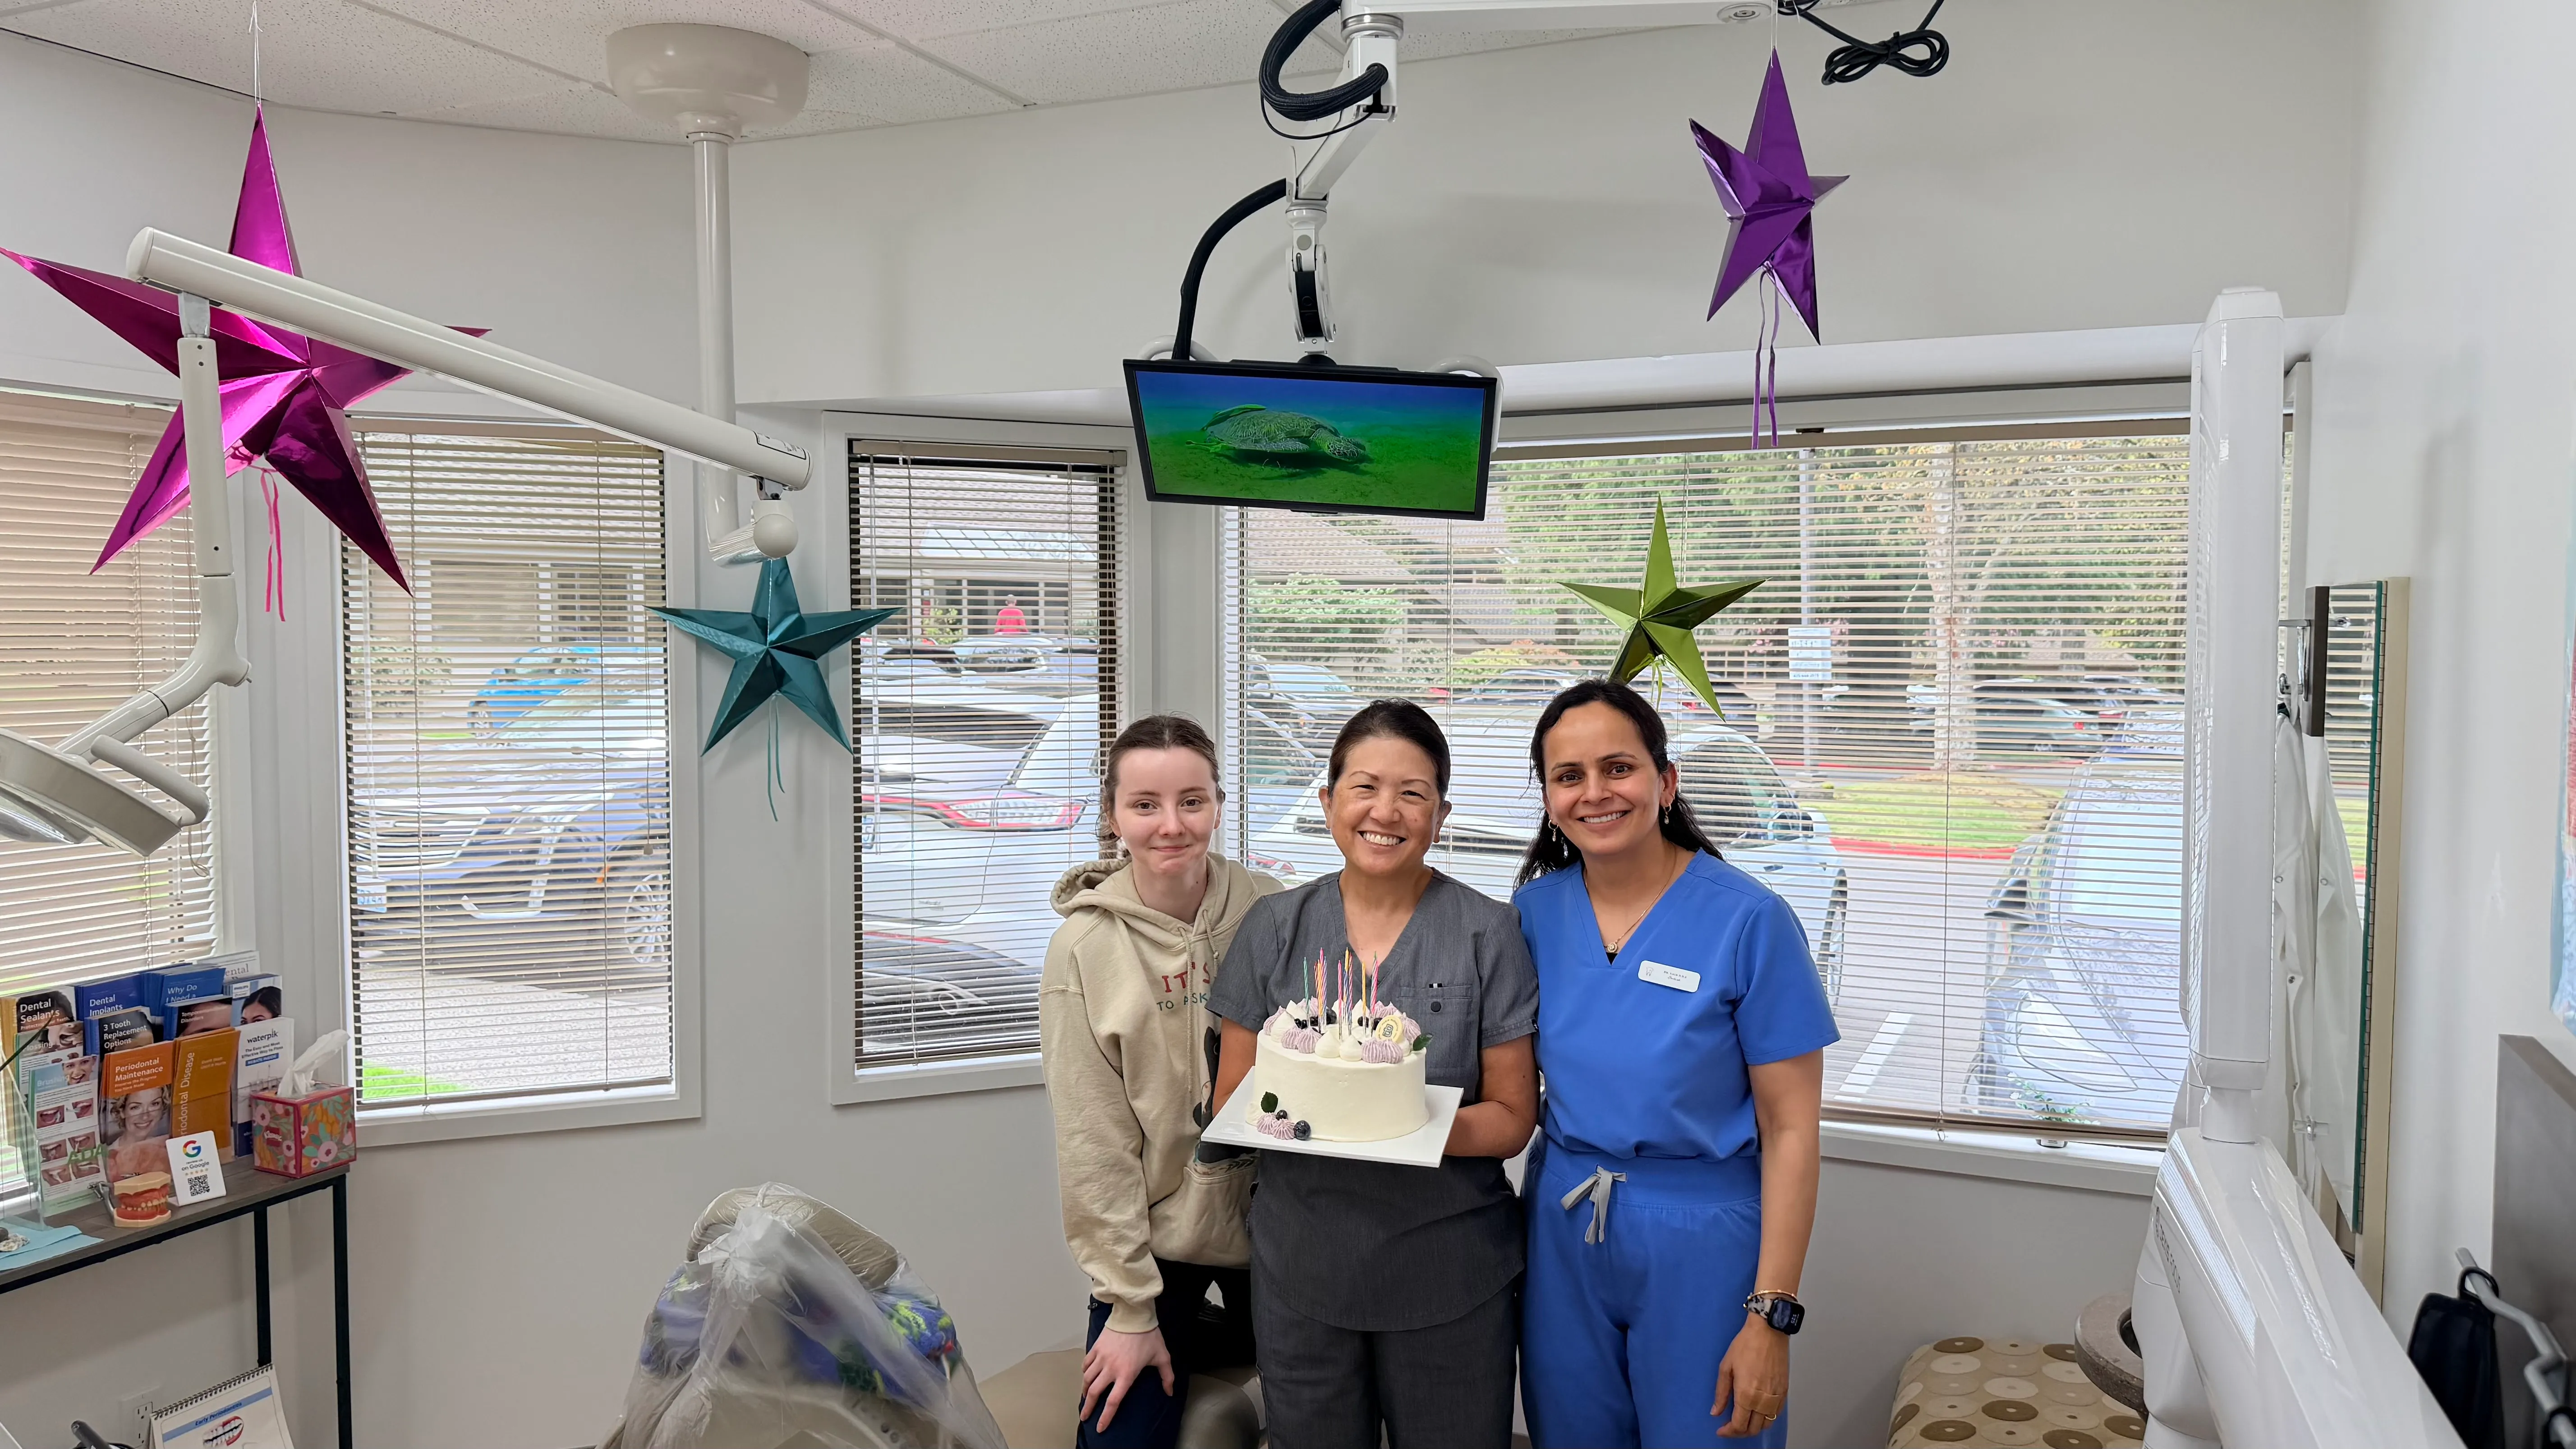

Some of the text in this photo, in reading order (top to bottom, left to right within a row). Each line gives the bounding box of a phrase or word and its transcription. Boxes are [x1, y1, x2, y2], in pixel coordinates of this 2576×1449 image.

[225, 963, 249, 975] ental
[1162, 961, 1210, 993] IT'S
[20, 998, 51, 1013] Dental
[90, 994, 115, 1007] Dental
[1156, 1000, 1174, 1011] TO
[90, 1004, 123, 1017] Implants
[110, 1019, 131, 1029] Tooth
[104, 1025, 147, 1040] Replacement
[247, 1028, 279, 1043] waterpik
[104, 1038, 132, 1049] Options
[115, 1057, 159, 1073] Periodontal
[115, 1066, 163, 1081] Maintenance
[179, 1052, 195, 1136] riodontal Disease
[189, 1161, 209, 1169] Google
[195, 1402, 242, 1426] Early Periodontitis
